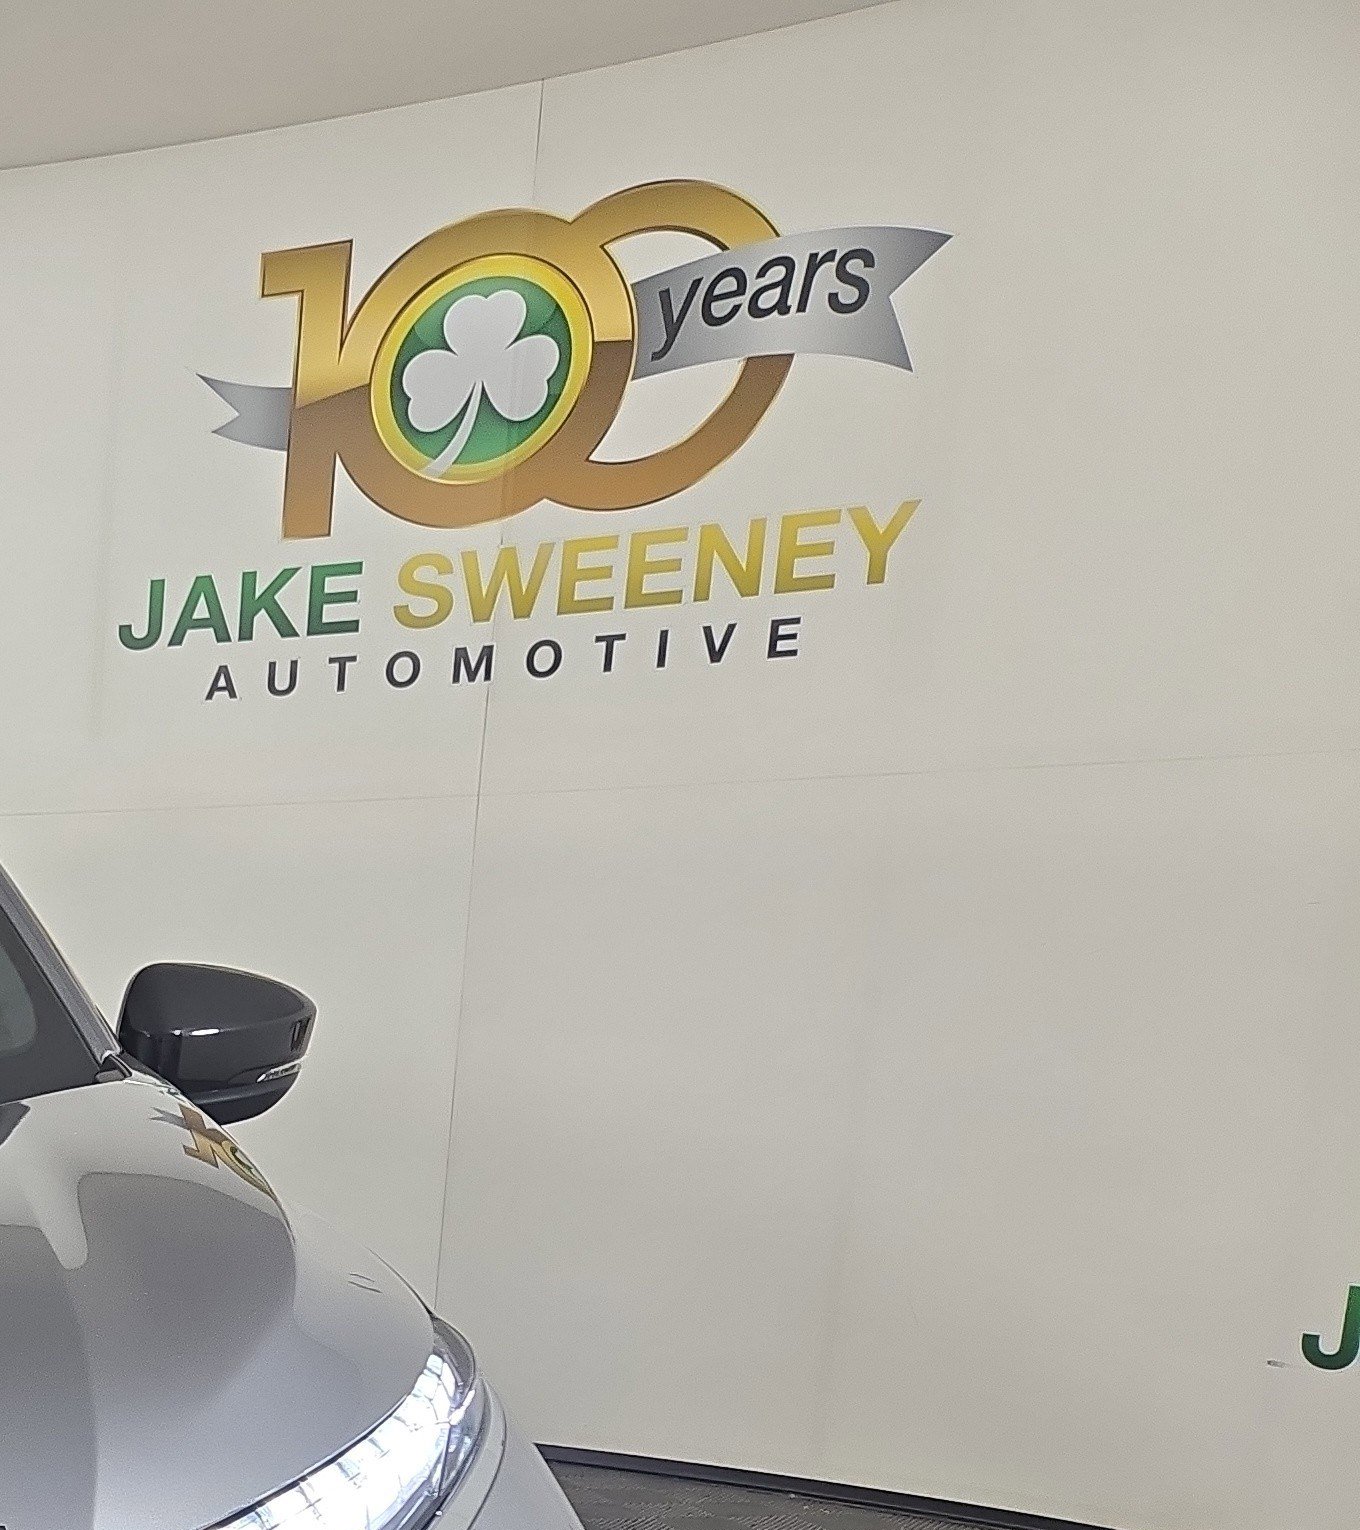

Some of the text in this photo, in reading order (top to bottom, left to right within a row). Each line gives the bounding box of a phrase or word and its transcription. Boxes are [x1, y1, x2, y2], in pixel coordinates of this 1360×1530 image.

[651, 244, 875, 362] years
[118, 499, 921, 651] JAKE SWEENEY
[205, 618, 803, 702] AUTOMOTIVE
